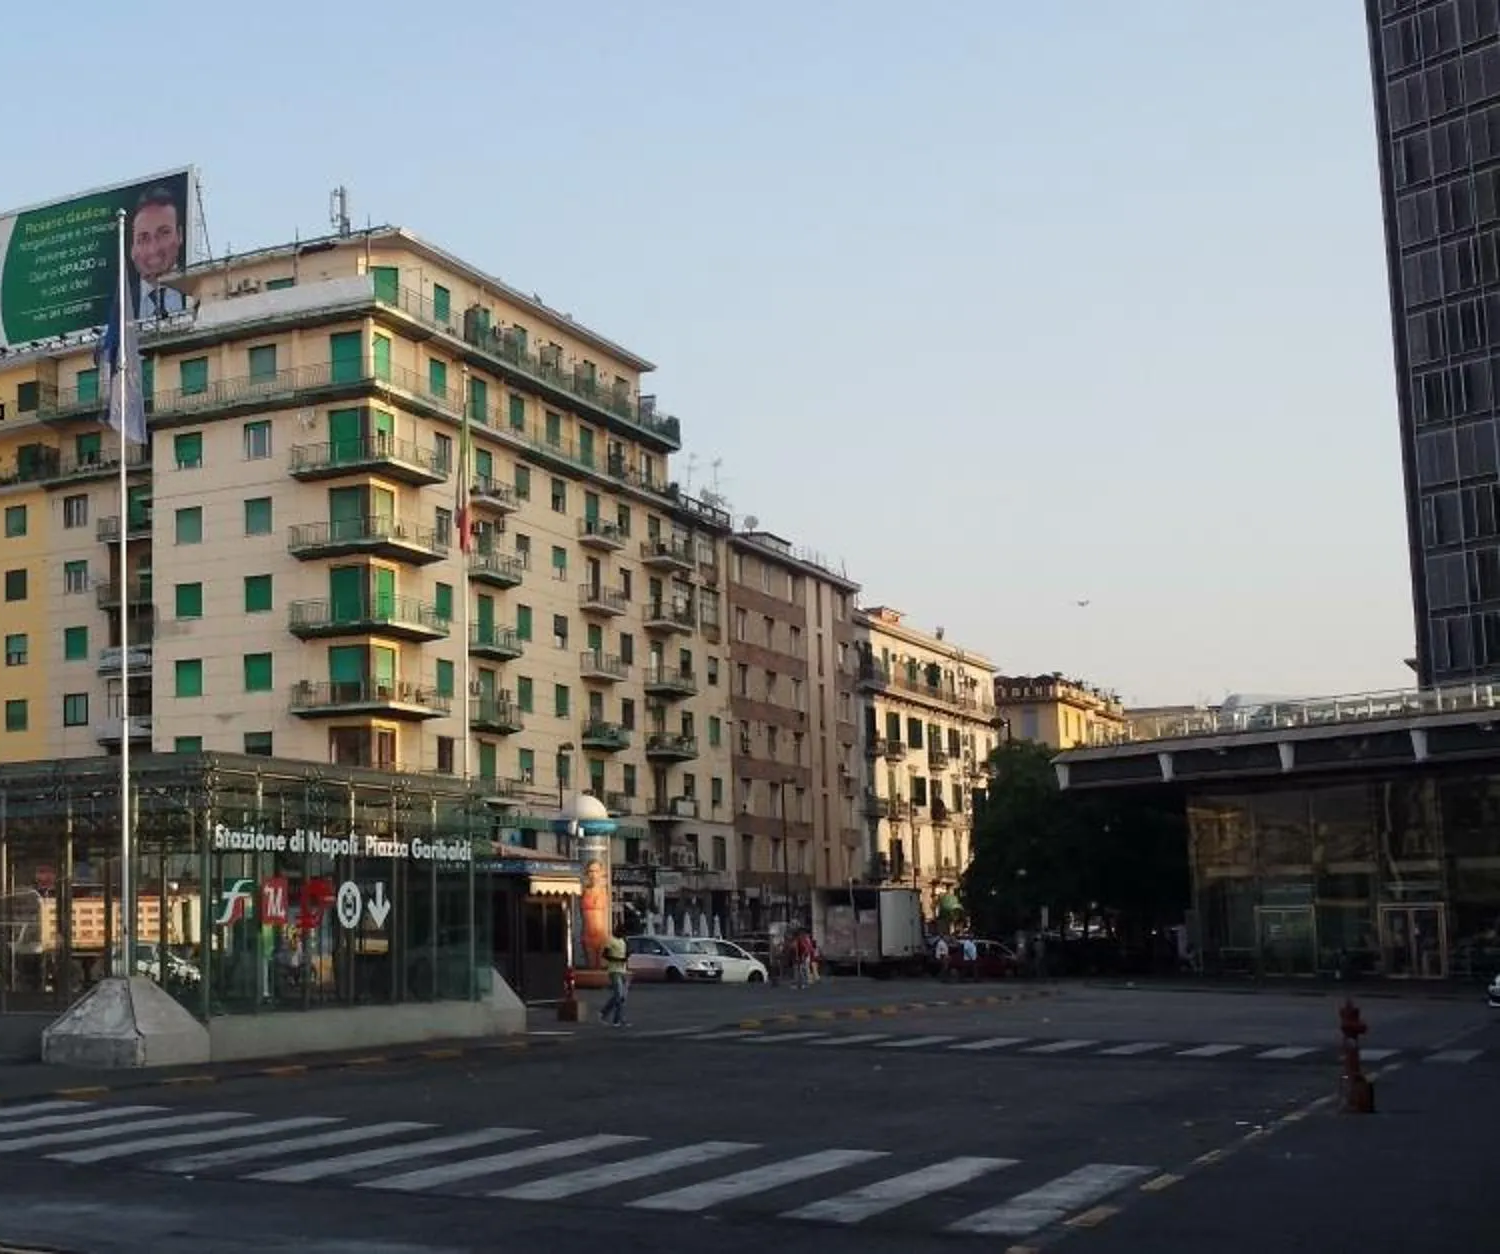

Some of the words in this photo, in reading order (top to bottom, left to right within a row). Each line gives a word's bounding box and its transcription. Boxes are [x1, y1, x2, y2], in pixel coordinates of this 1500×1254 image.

[60, 257, 97, 276] SPAZIO
[215, 824, 287, 851] Stazione
[290, 830, 304, 852] di
[309, 830, 358, 862] Napoli
[365, 835, 410, 857] Piazza
[411, 838, 472, 861] Garibaldi
